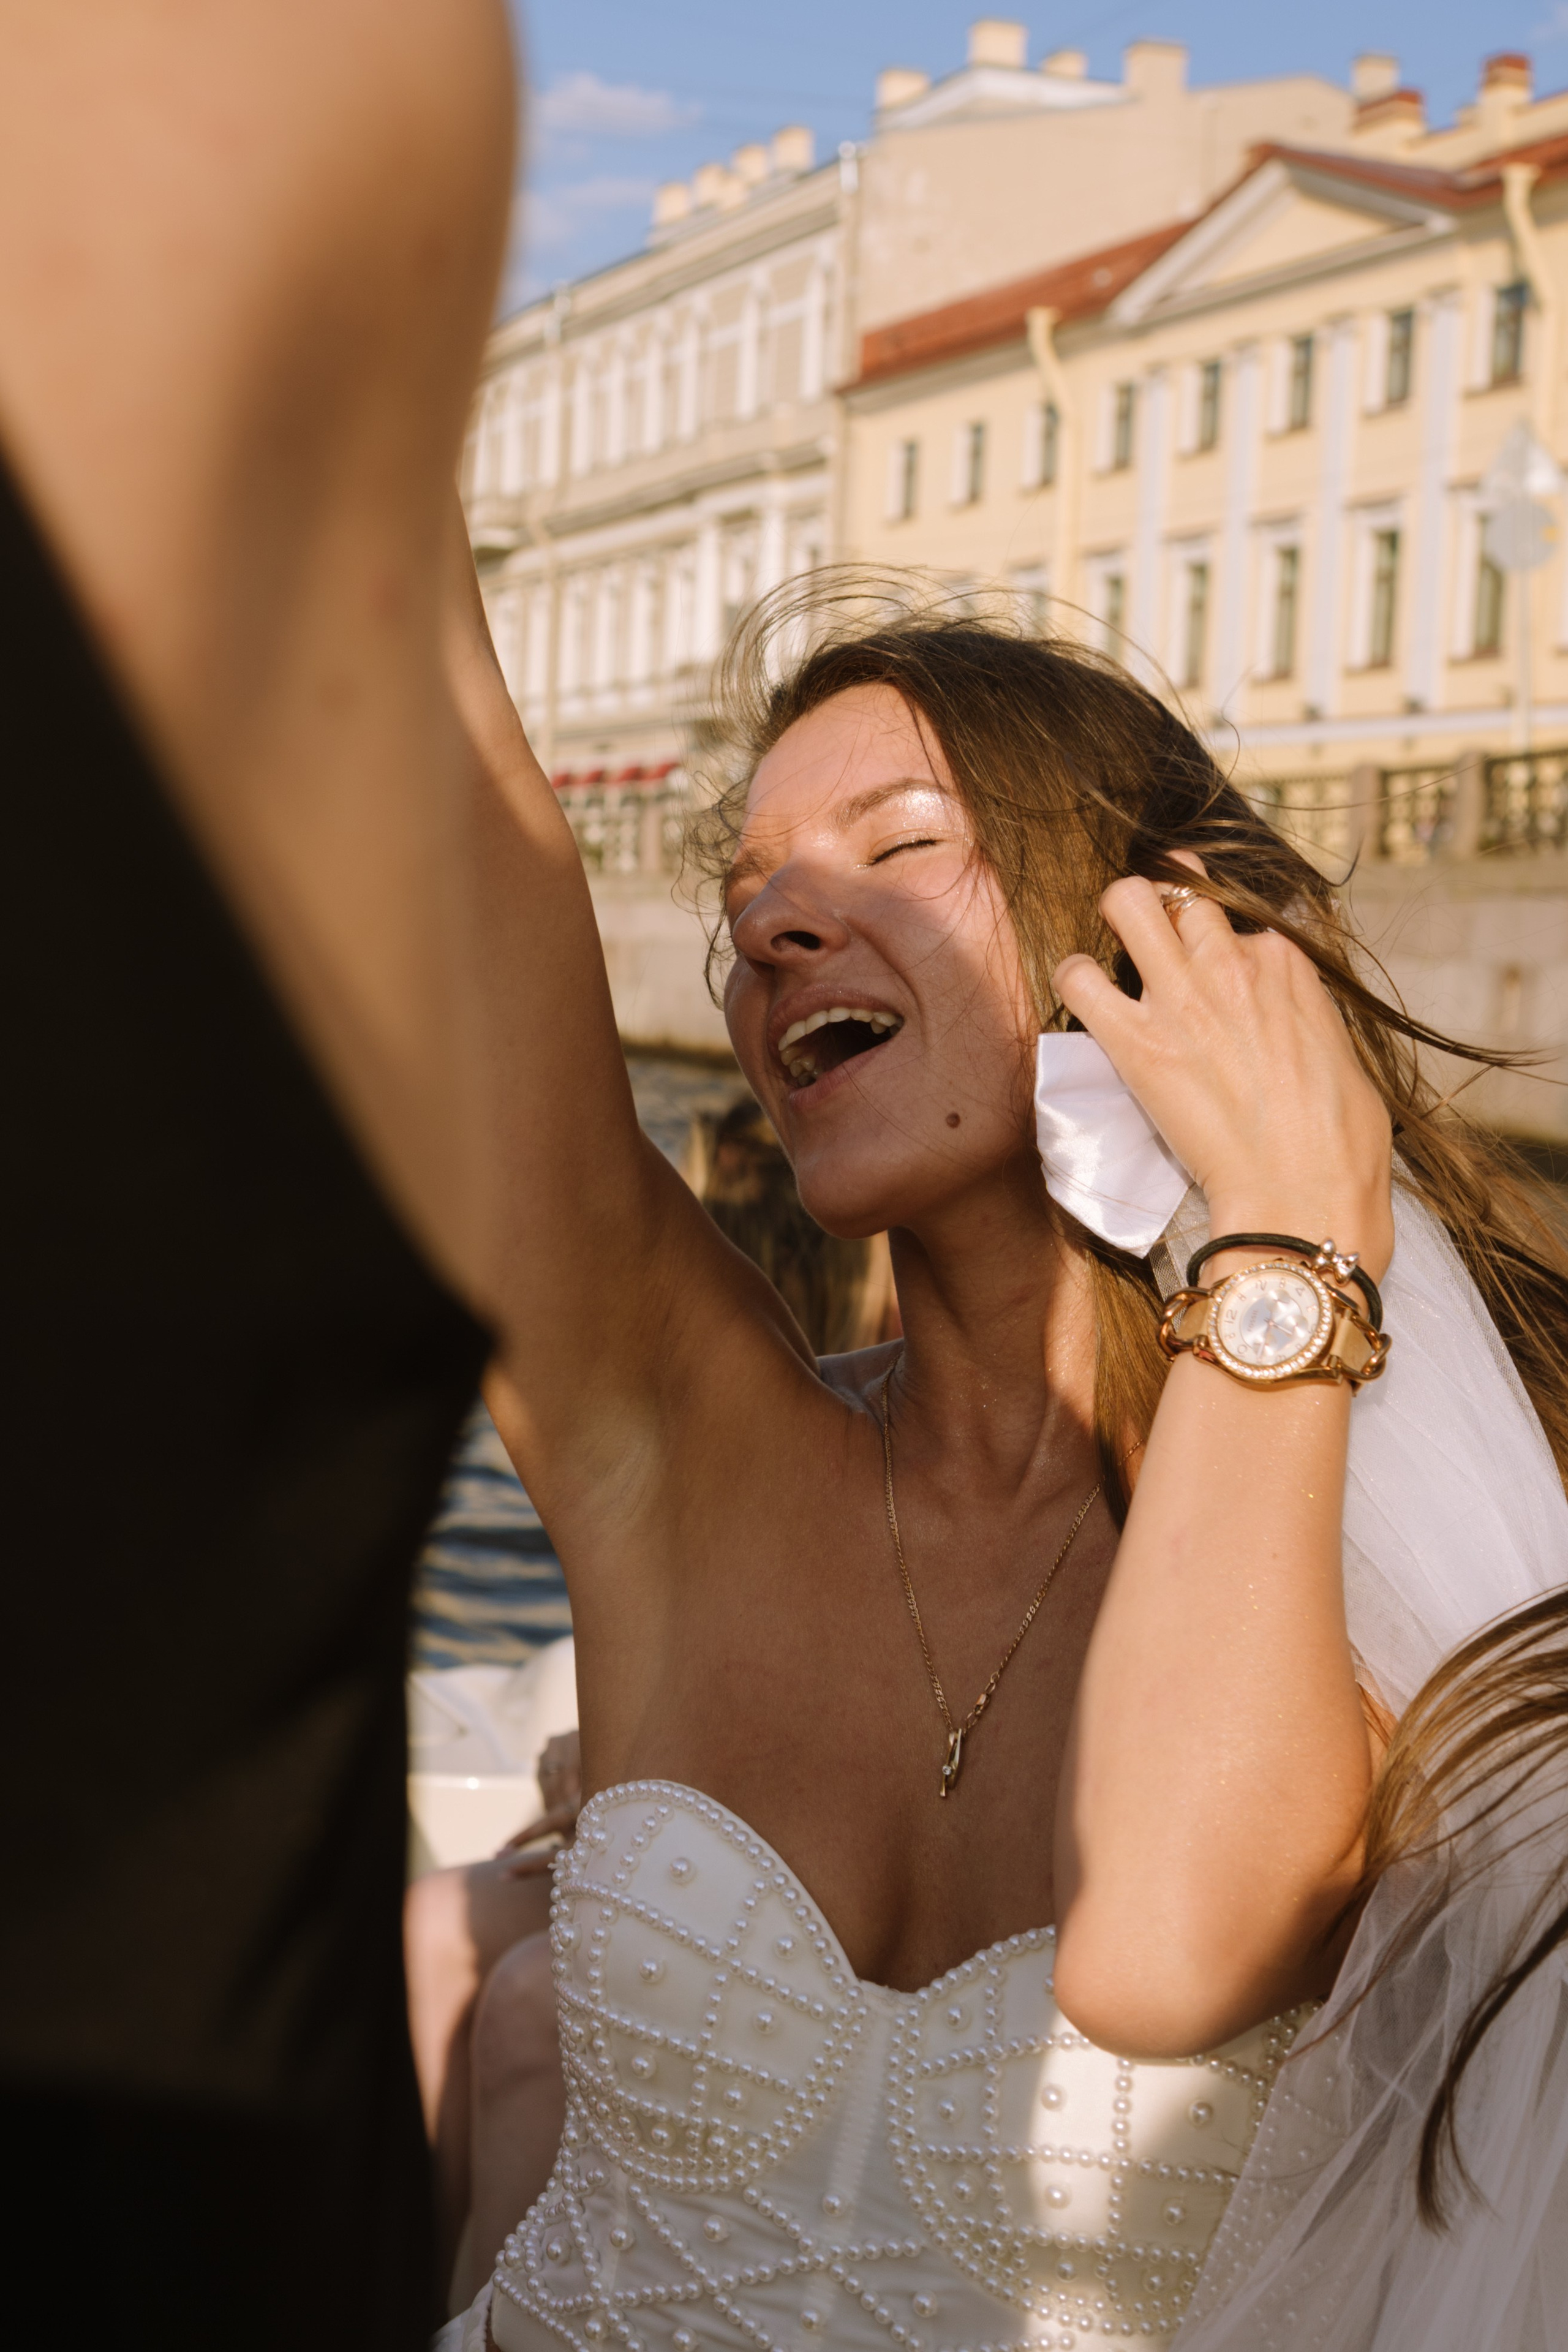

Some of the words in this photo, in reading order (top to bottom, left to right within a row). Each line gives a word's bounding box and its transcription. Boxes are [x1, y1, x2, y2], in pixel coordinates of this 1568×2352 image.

[1225, 1310, 1237, 1324] 12
[1248, 1310, 1259, 1332] FOSSIL
[1238, 1344, 1248, 1357] 10
